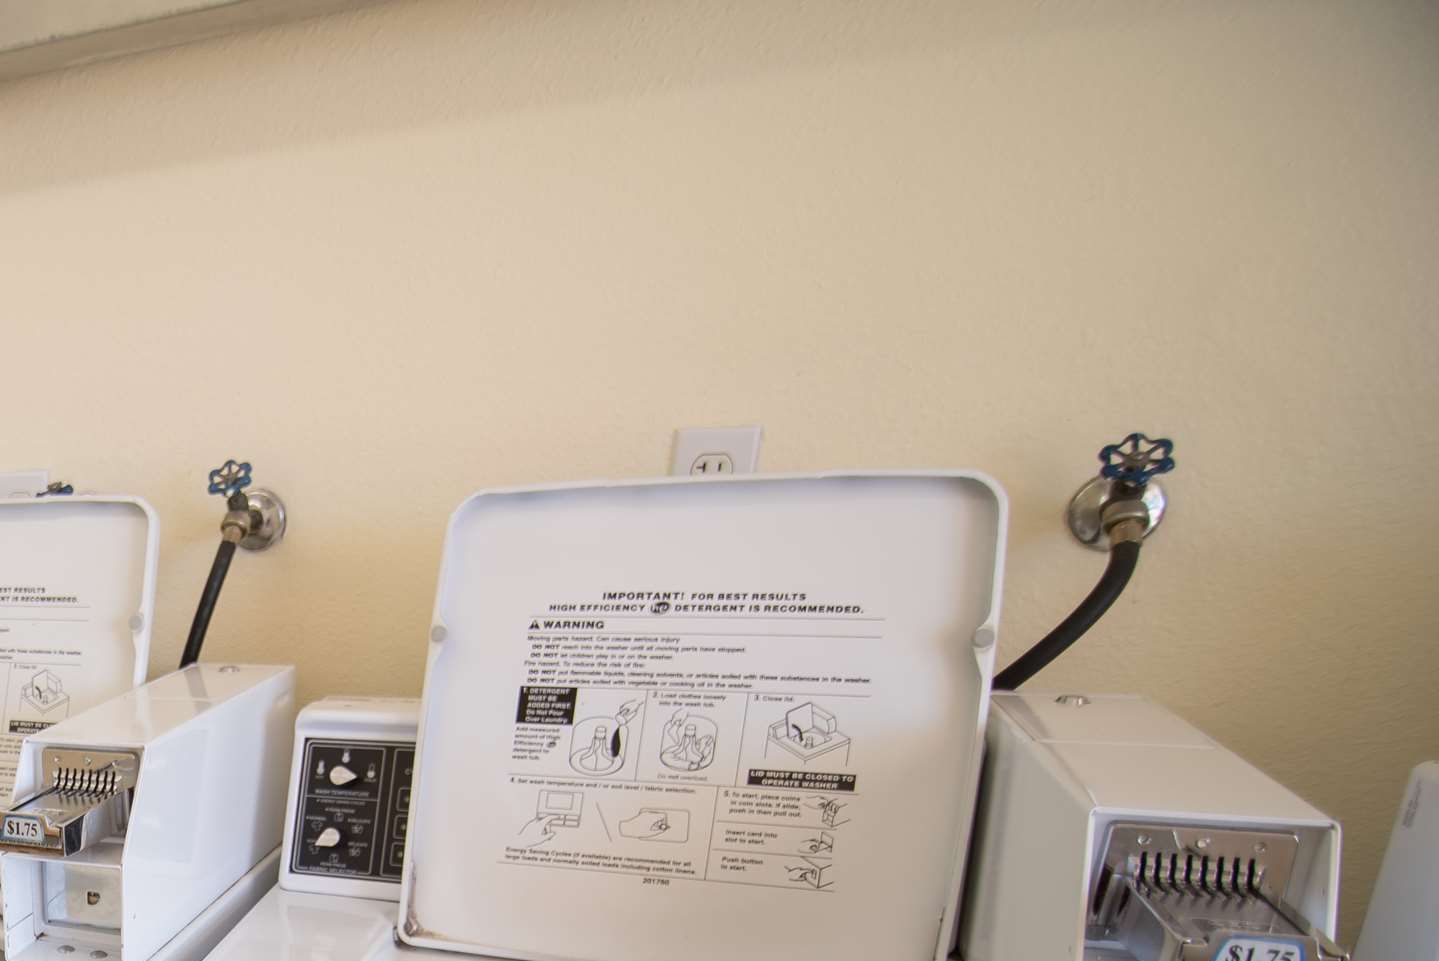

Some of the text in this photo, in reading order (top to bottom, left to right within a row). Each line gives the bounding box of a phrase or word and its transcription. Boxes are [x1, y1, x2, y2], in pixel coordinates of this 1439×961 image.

[602, 592, 684, 600] IMPORTANT!
[579, 604, 645, 612] EFFICIENCY
[673, 604, 744, 612] DETERGENT
[763, 605, 864, 613] RECOMMENDED.
[542, 620, 604, 629] WARNING
[529, 687, 569, 695] DETERGENT
[805, 773, 839, 781] CLOSED
[761, 779, 838, 789] OPERATE WASHER
[7, 820, 38, 838] $1.75
